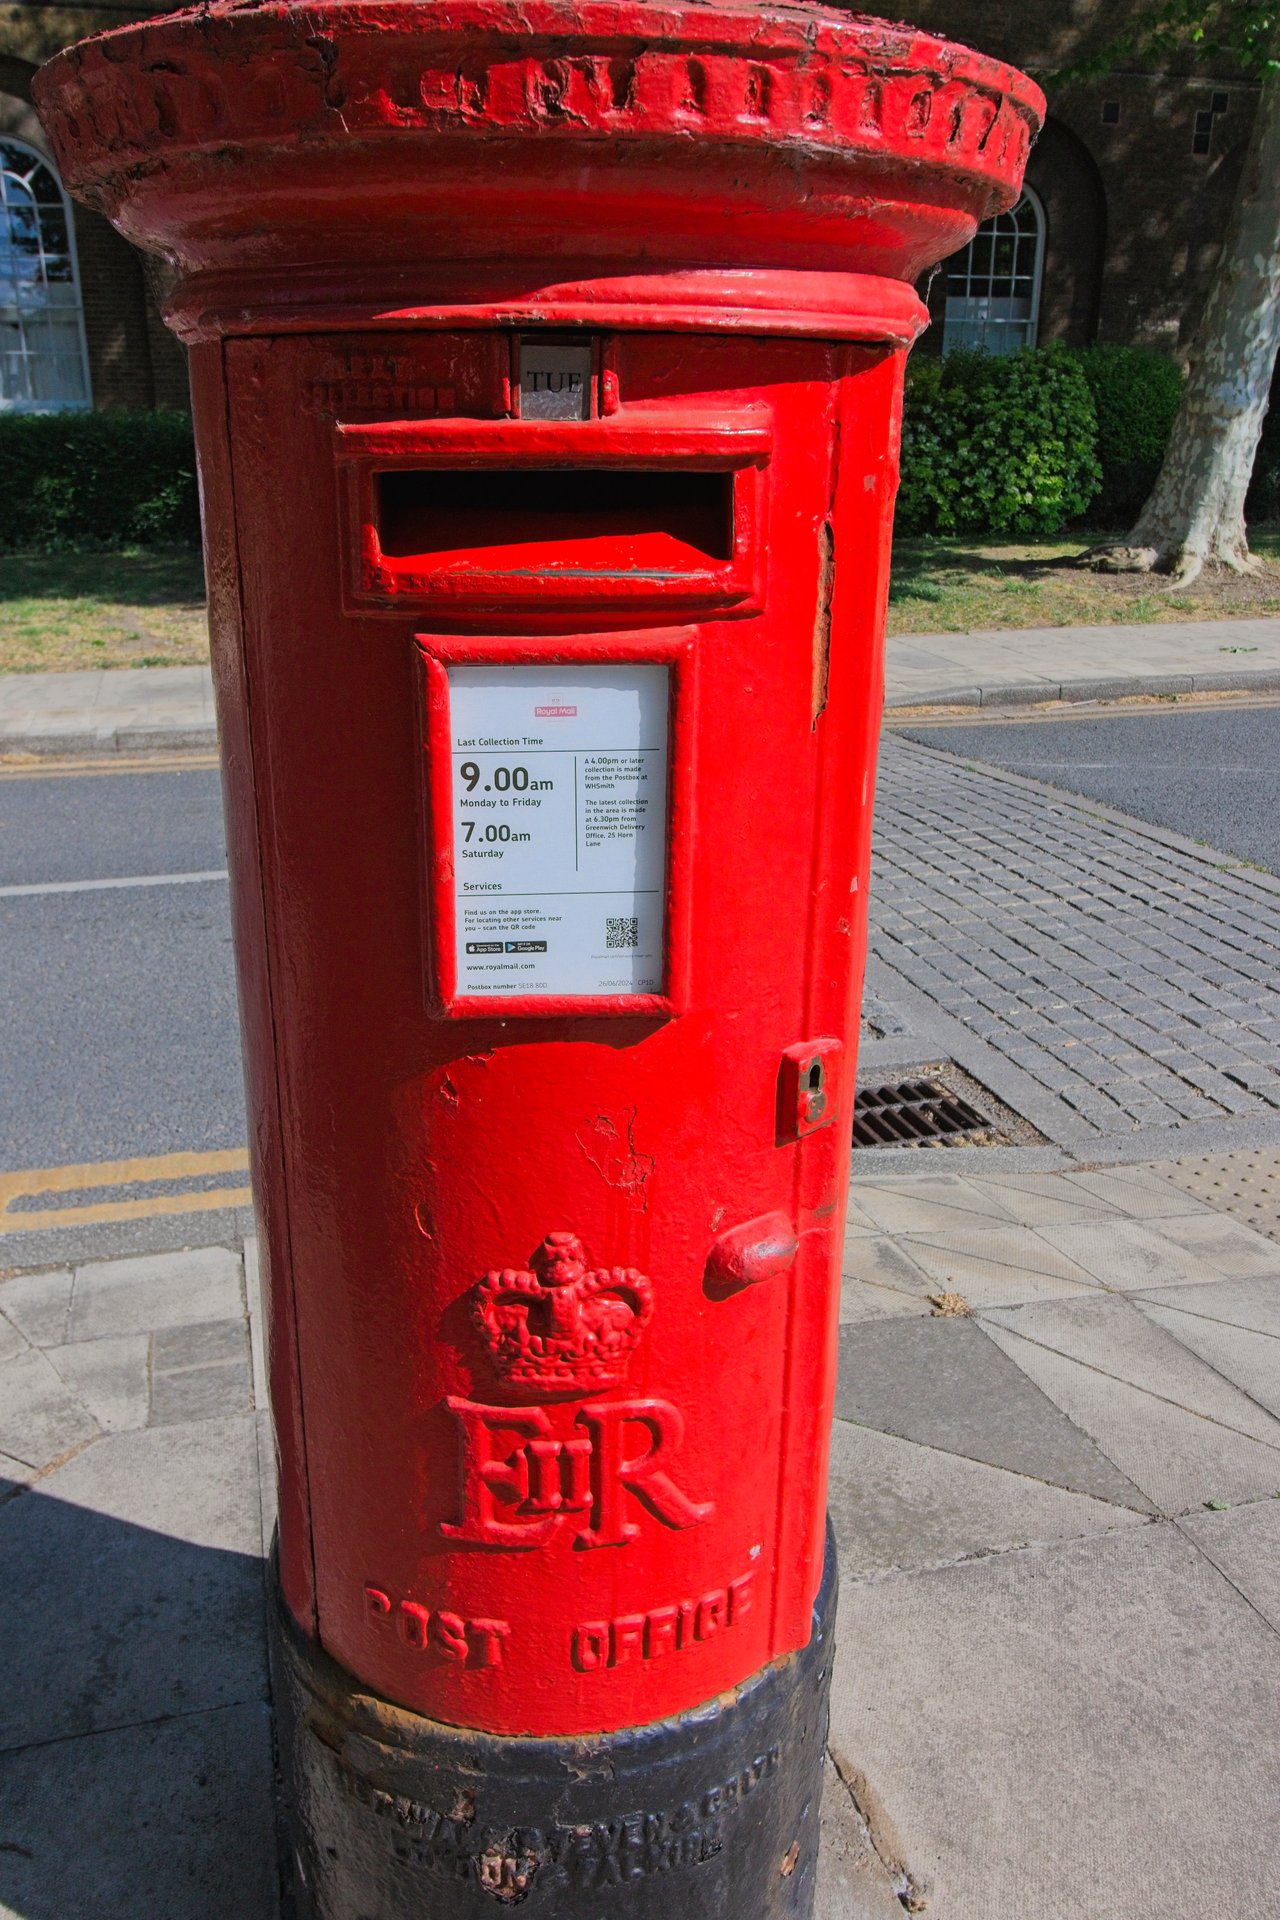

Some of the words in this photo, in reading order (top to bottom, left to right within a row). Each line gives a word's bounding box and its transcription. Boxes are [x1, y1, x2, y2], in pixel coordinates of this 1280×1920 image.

[526, 370, 583, 393] TUE
[536, 707, 557, 716] Royal
[559, 707, 575, 715] Mail
[458, 738, 476, 747] Last
[478, 737, 520, 746] Collection
[522, 737, 544, 746] Time
[591, 757, 618, 765] 4.00pm
[460, 761, 554, 792] 9.00am
[584, 782, 614, 790] WHSmith
[460, 798, 496, 809] Monday
[500, 798, 510, 807] to
[512, 798, 542, 807] Friday
[594, 815, 620, 824] 6.30pm
[461, 821, 530, 843] 7.00am
[462, 849, 504, 859] Saturday
[464, 882, 502, 891] Services
[476, 916, 502, 924] locating
[466, 962, 536, 971] www.royalmail.com
[363, 1582, 512, 1671] POST
[570, 1571, 756, 1673] OFFICE
